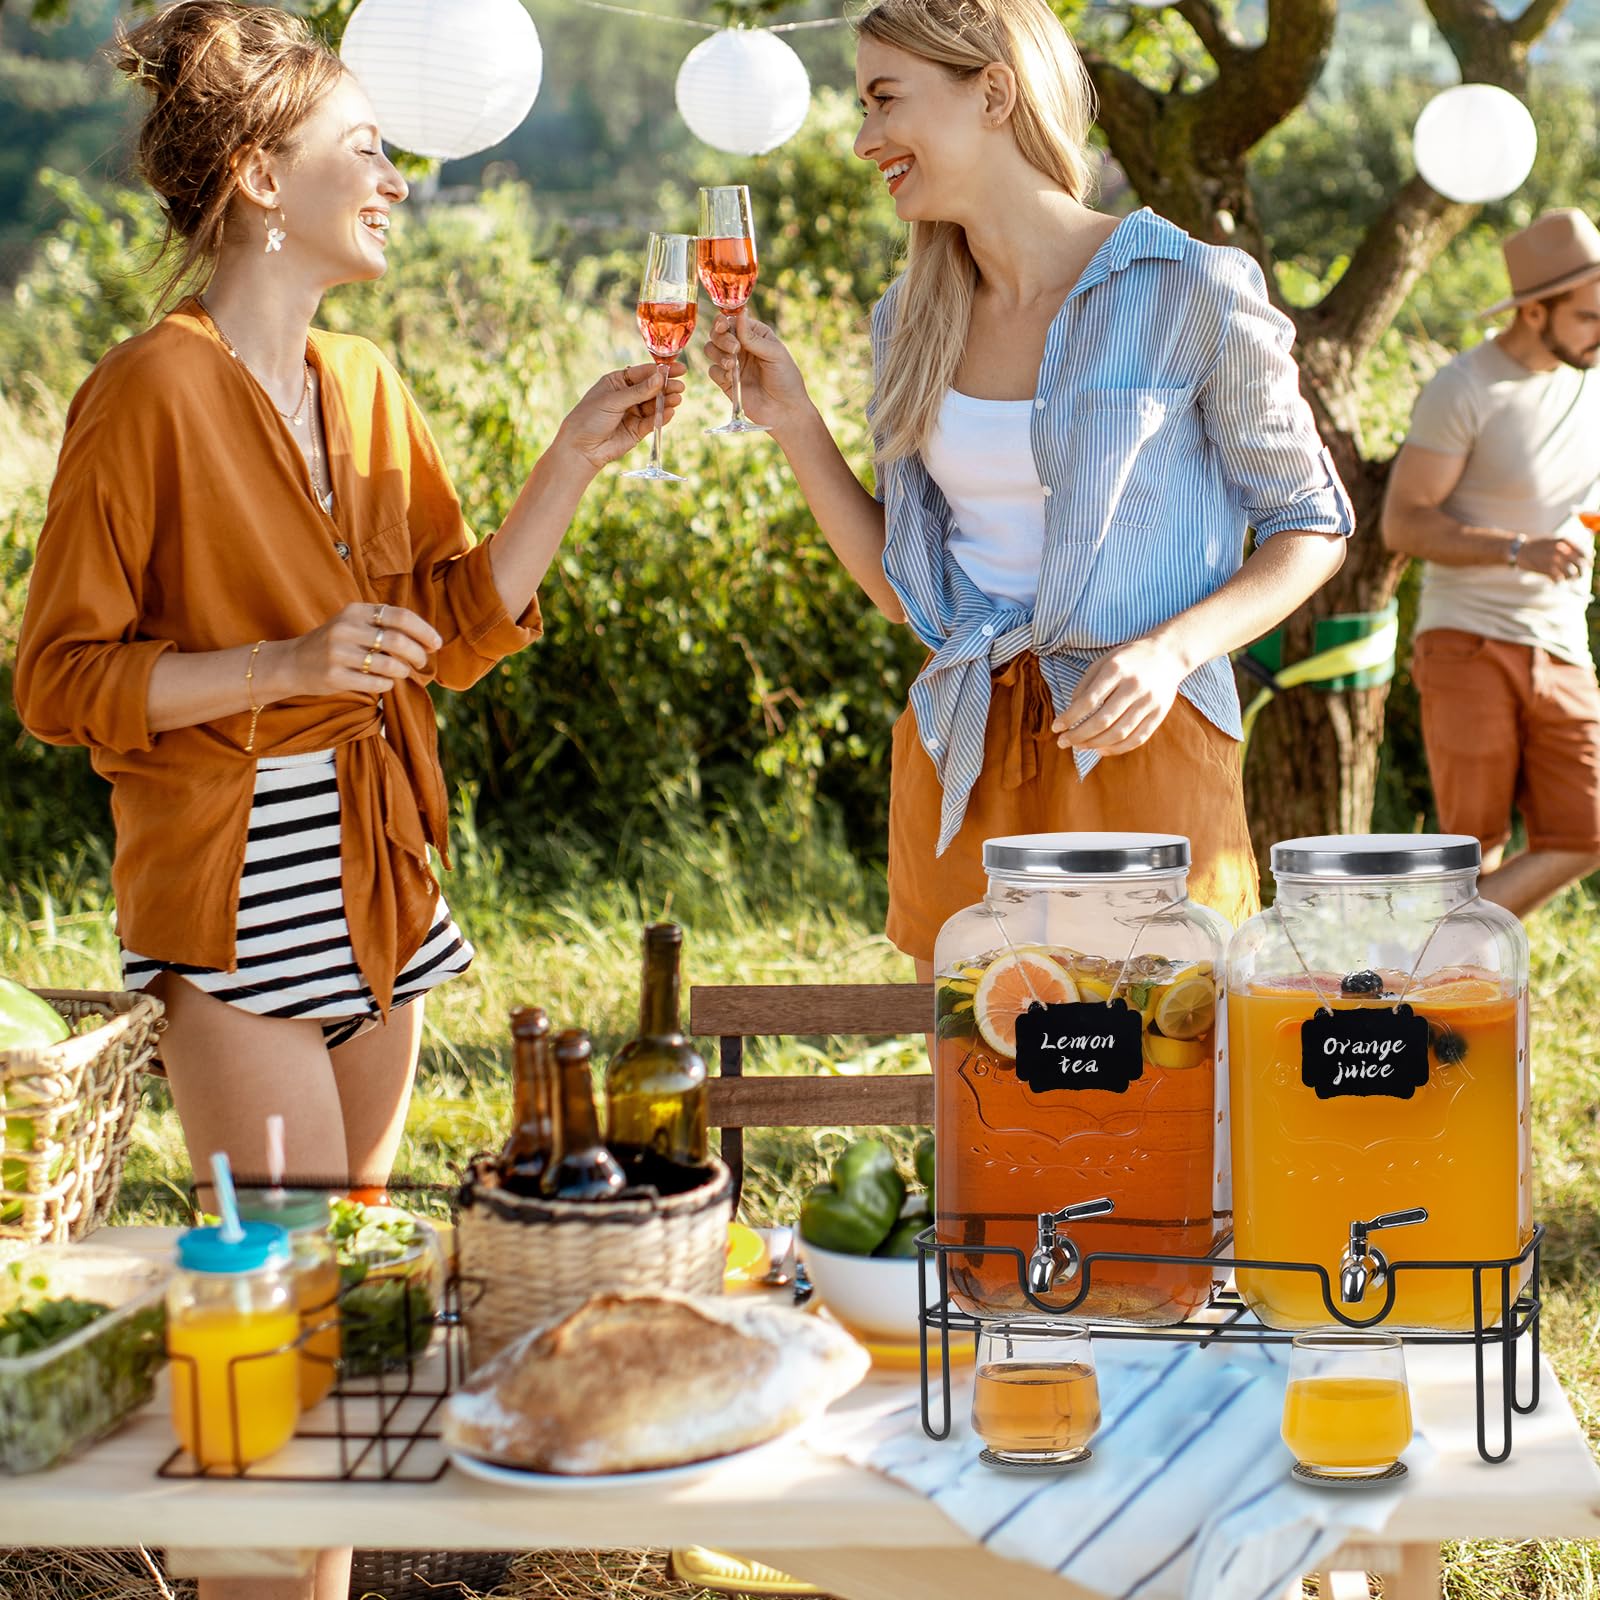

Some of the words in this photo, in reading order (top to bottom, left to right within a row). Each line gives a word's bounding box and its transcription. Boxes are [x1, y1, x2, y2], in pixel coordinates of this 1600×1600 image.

[1040, 1032, 1115, 1050] Lemon
[1323, 1037, 1406, 1062] Orange
[1058, 1055, 1099, 1074] tea
[1332, 1060, 1395, 1086] juice
